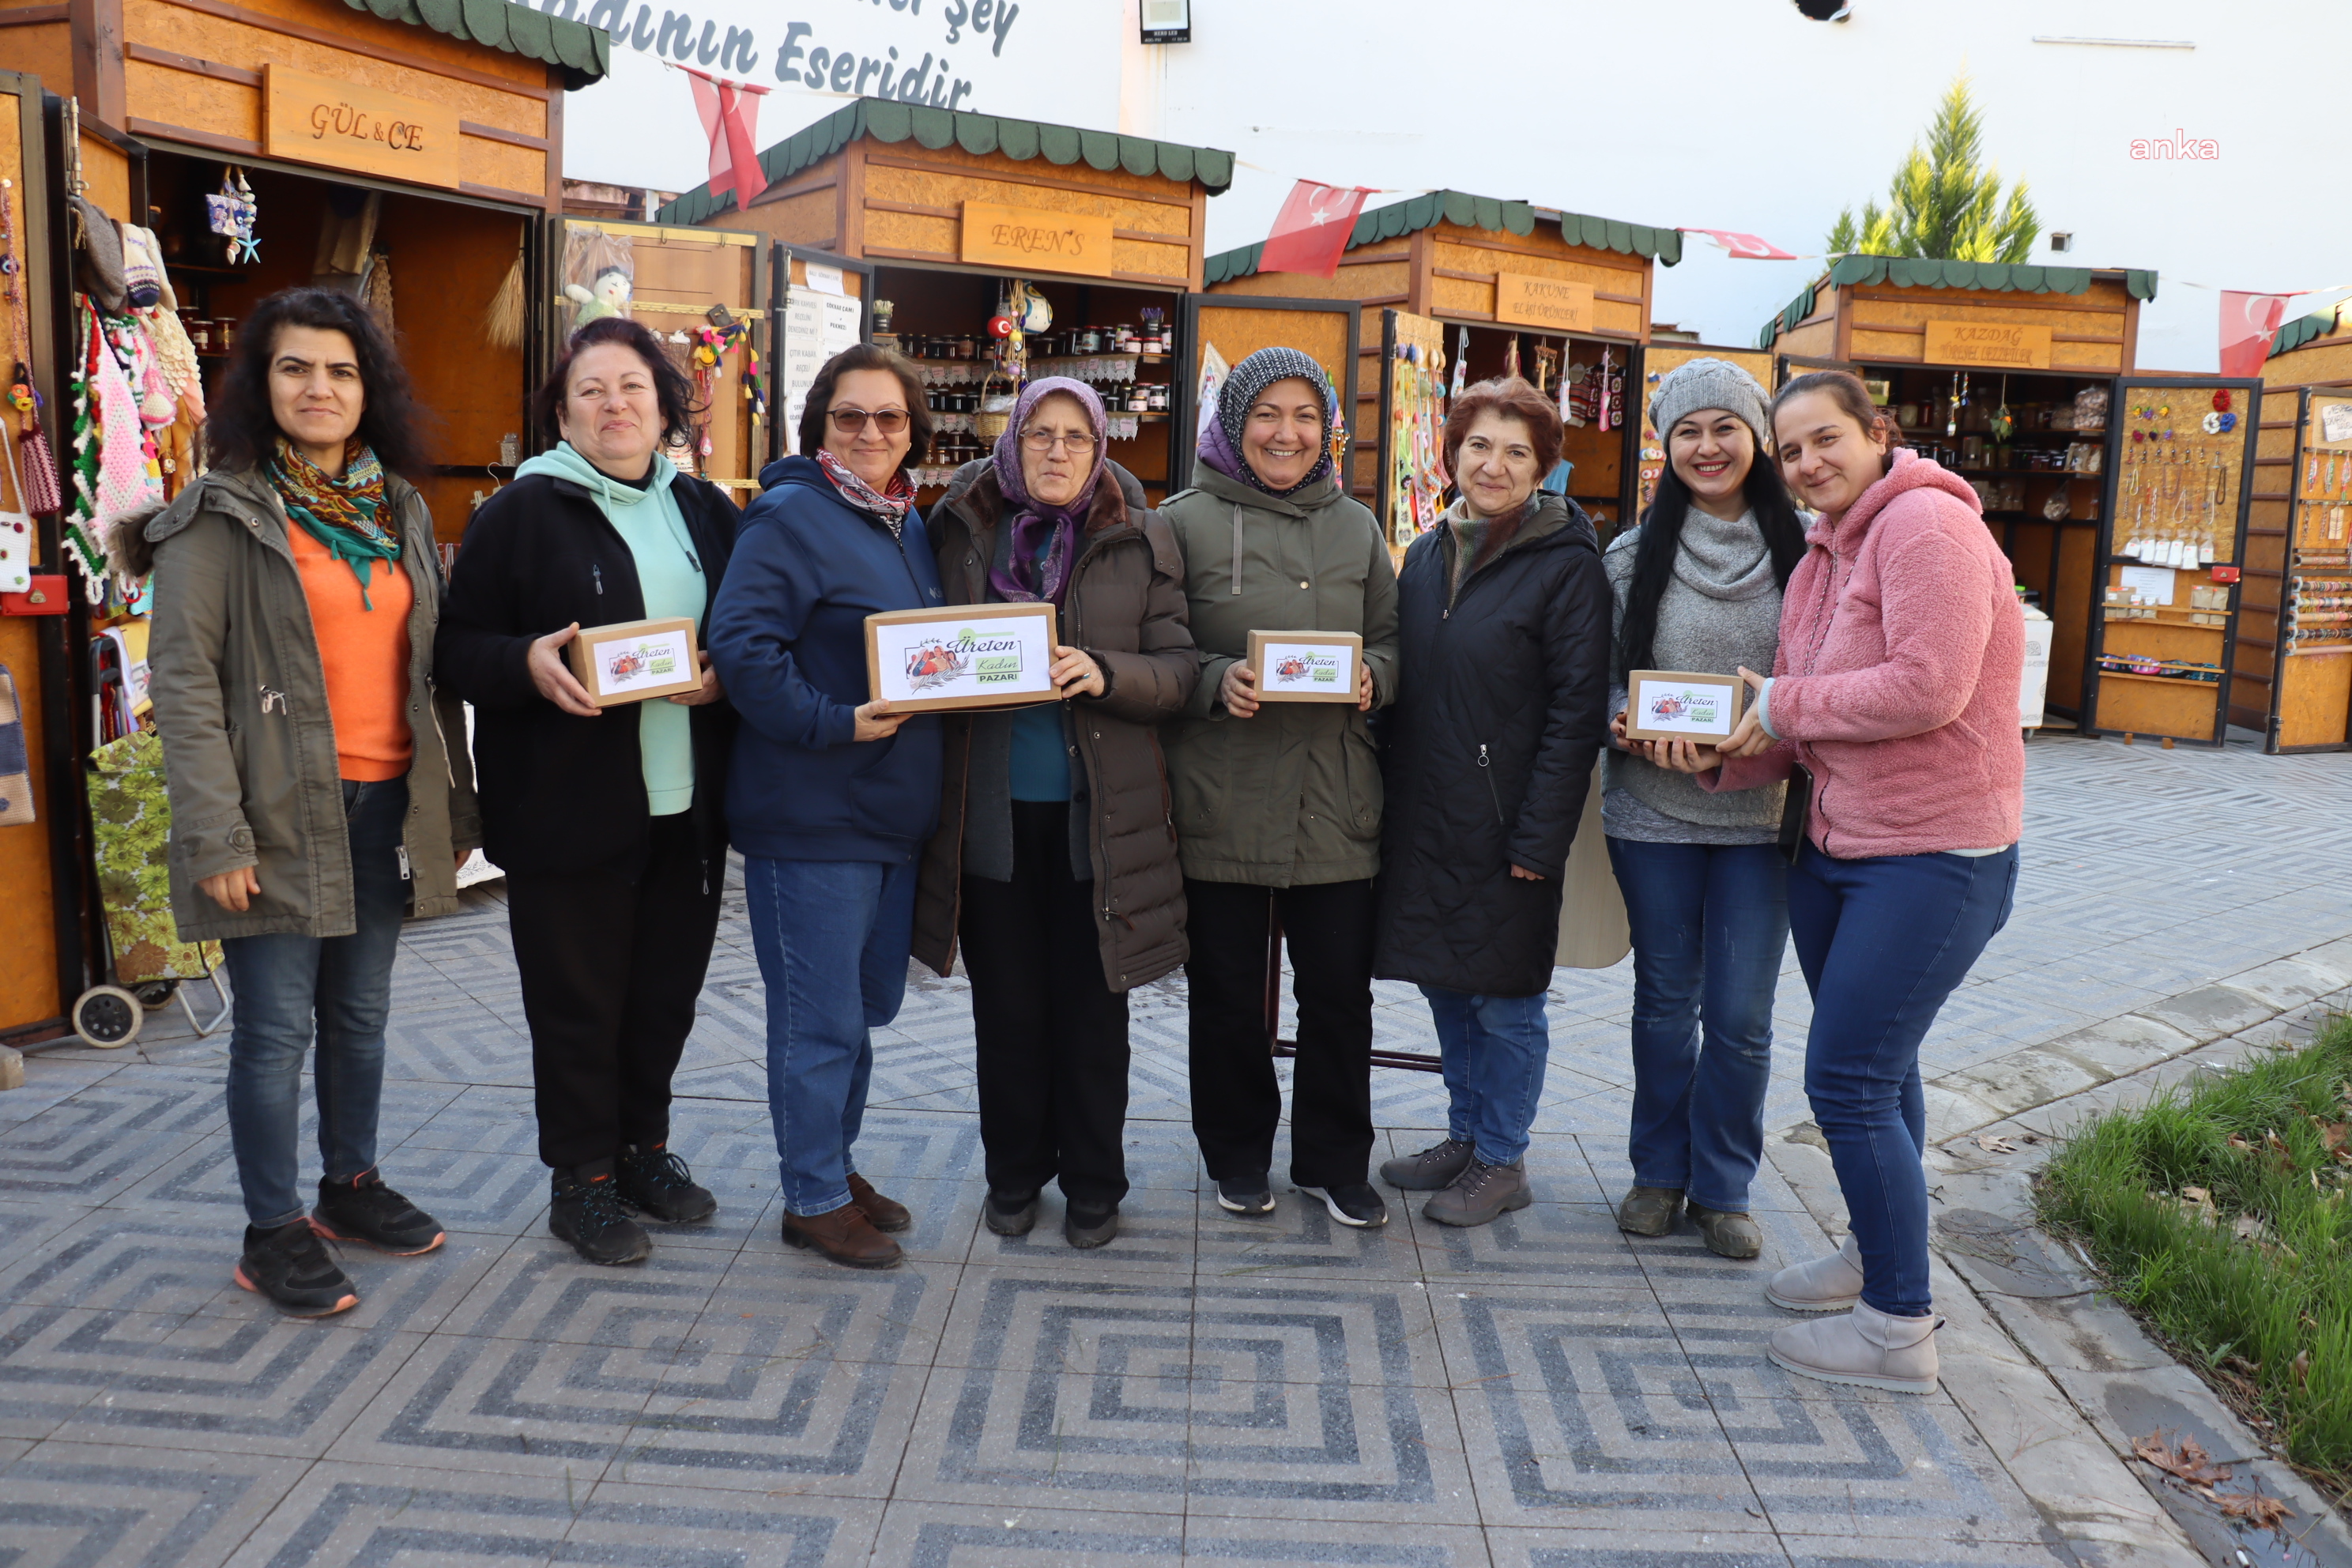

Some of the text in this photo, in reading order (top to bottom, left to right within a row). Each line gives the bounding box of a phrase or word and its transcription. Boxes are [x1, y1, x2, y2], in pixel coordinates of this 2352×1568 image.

[311, 102, 424, 152] GÜL & CE
[946, 636, 1016, 654] Üreten
[632, 647, 671, 659] Üreten
[978, 659, 1018, 671] Kadın
[1298, 655, 1336, 666] Üreten
[979, 673, 1017, 682] PAZARI
[1675, 695, 1715, 706] Üreten
